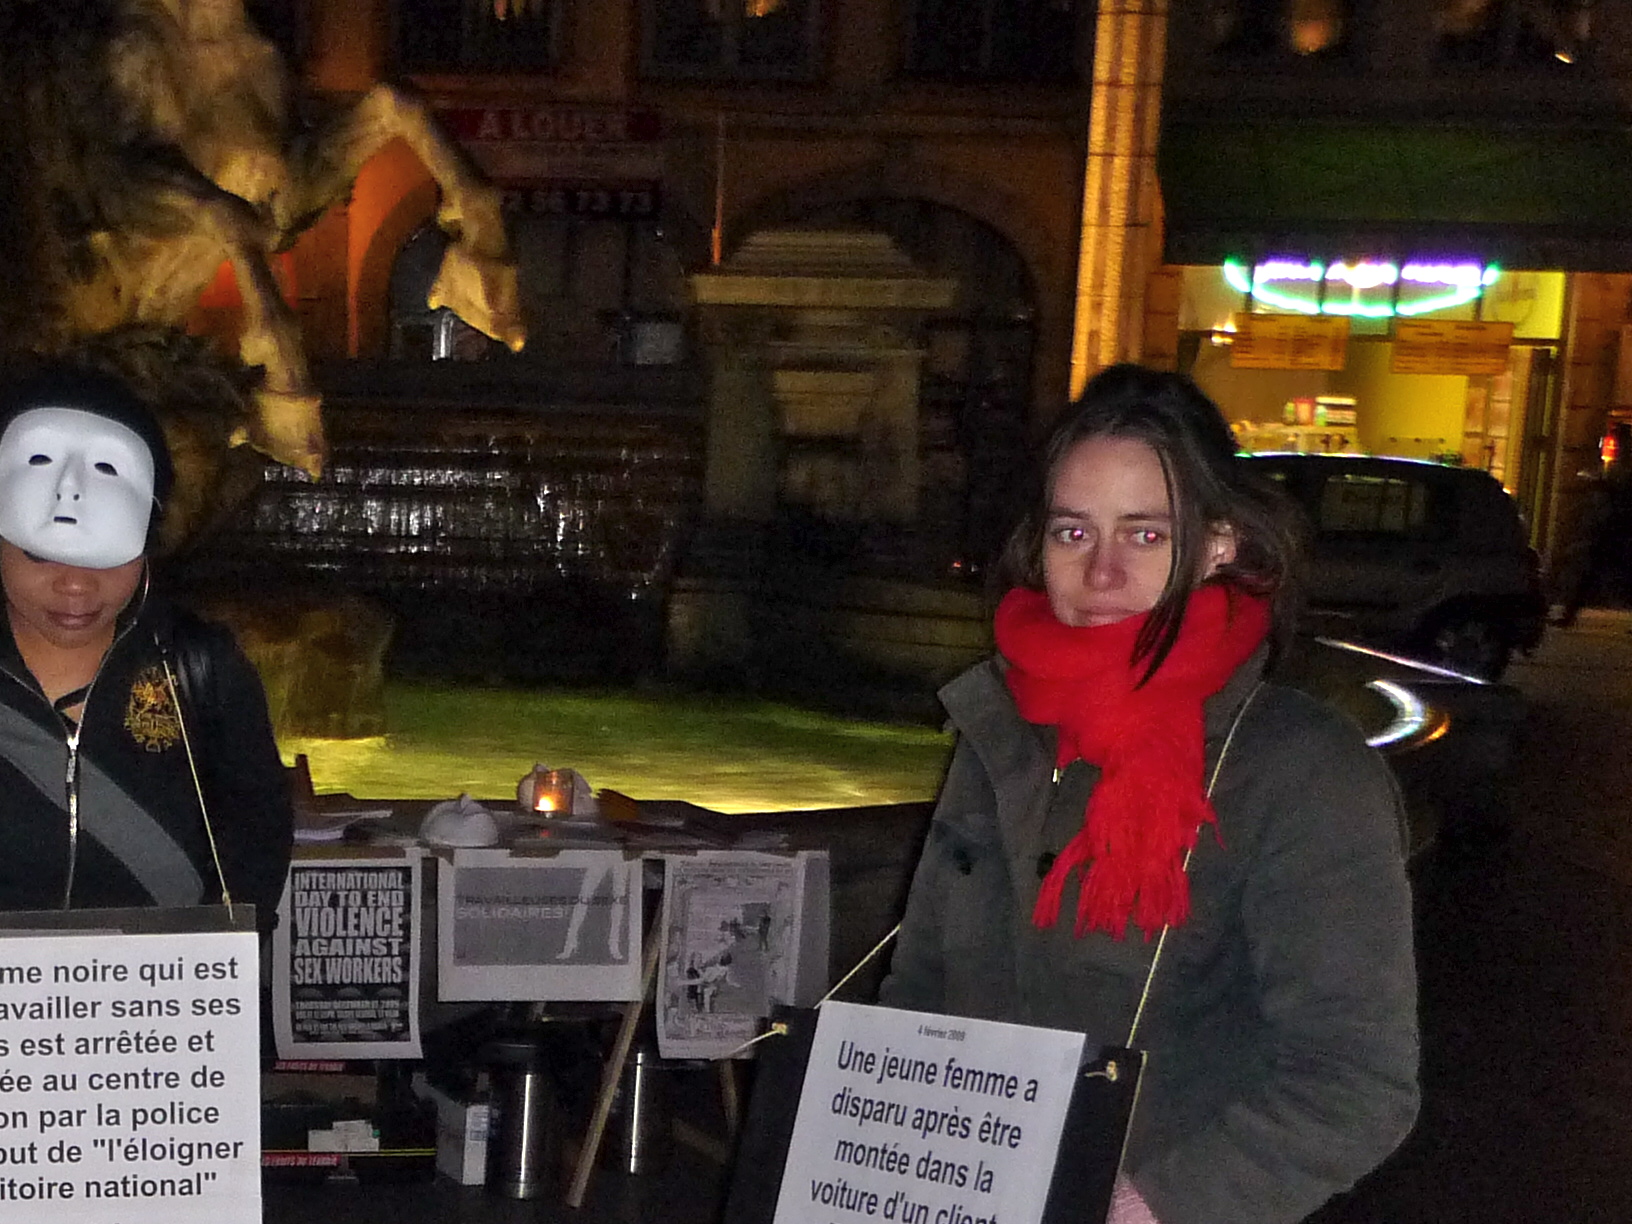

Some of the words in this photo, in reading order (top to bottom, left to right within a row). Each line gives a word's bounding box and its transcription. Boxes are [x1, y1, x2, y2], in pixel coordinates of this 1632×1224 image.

[294, 872, 405, 890] INTERNATIONAL
[294, 890, 332, 907] DAY
[336, 890, 362, 907] TO
[366, 890, 405, 907] END
[295, 906, 404, 937] VIOLENCE
[294, 938, 404, 956] AGAINST
[53, 958, 129, 984] noire
[138, 956, 184, 988] qui
[193, 956, 239, 981] est
[294, 957, 323, 985] SEX
[325, 956, 403, 985] WORKERS
[110, 998, 181, 1018] sans
[191, 997, 241, 1017] ses
[19, 1032, 66, 1057] est
[74, 1028, 178, 1056] arrêtée
[187, 1029, 215, 1053] et
[42, 1073, 77, 1092] au
[88, 1066, 181, 1091] centre
[190, 1064, 226, 1089] de
[837, 1040, 877, 1075] Une
[875, 1046, 938, 1086] jeune
[942, 1057, 1019, 1100] femme
[1023, 1078, 1039, 1103] a
[39, 1109, 88, 1135] par
[96, 1102, 122, 1127] la
[131, 1100, 220, 1132] police
[831, 1085, 909, 1128] disparu
[910, 1105, 973, 1140] après
[977, 1111, 1023, 1150] être
[47, 1139, 83, 1164] de
[92, 1136, 244, 1167] "l'éloigner
[833, 1139, 911, 1176] montée
[915, 1149, 970, 1189] dans
[973, 1159, 994, 1194] la
[85, 1171, 217, 1199] national"
[811, 1177, 879, 1216] voiture
